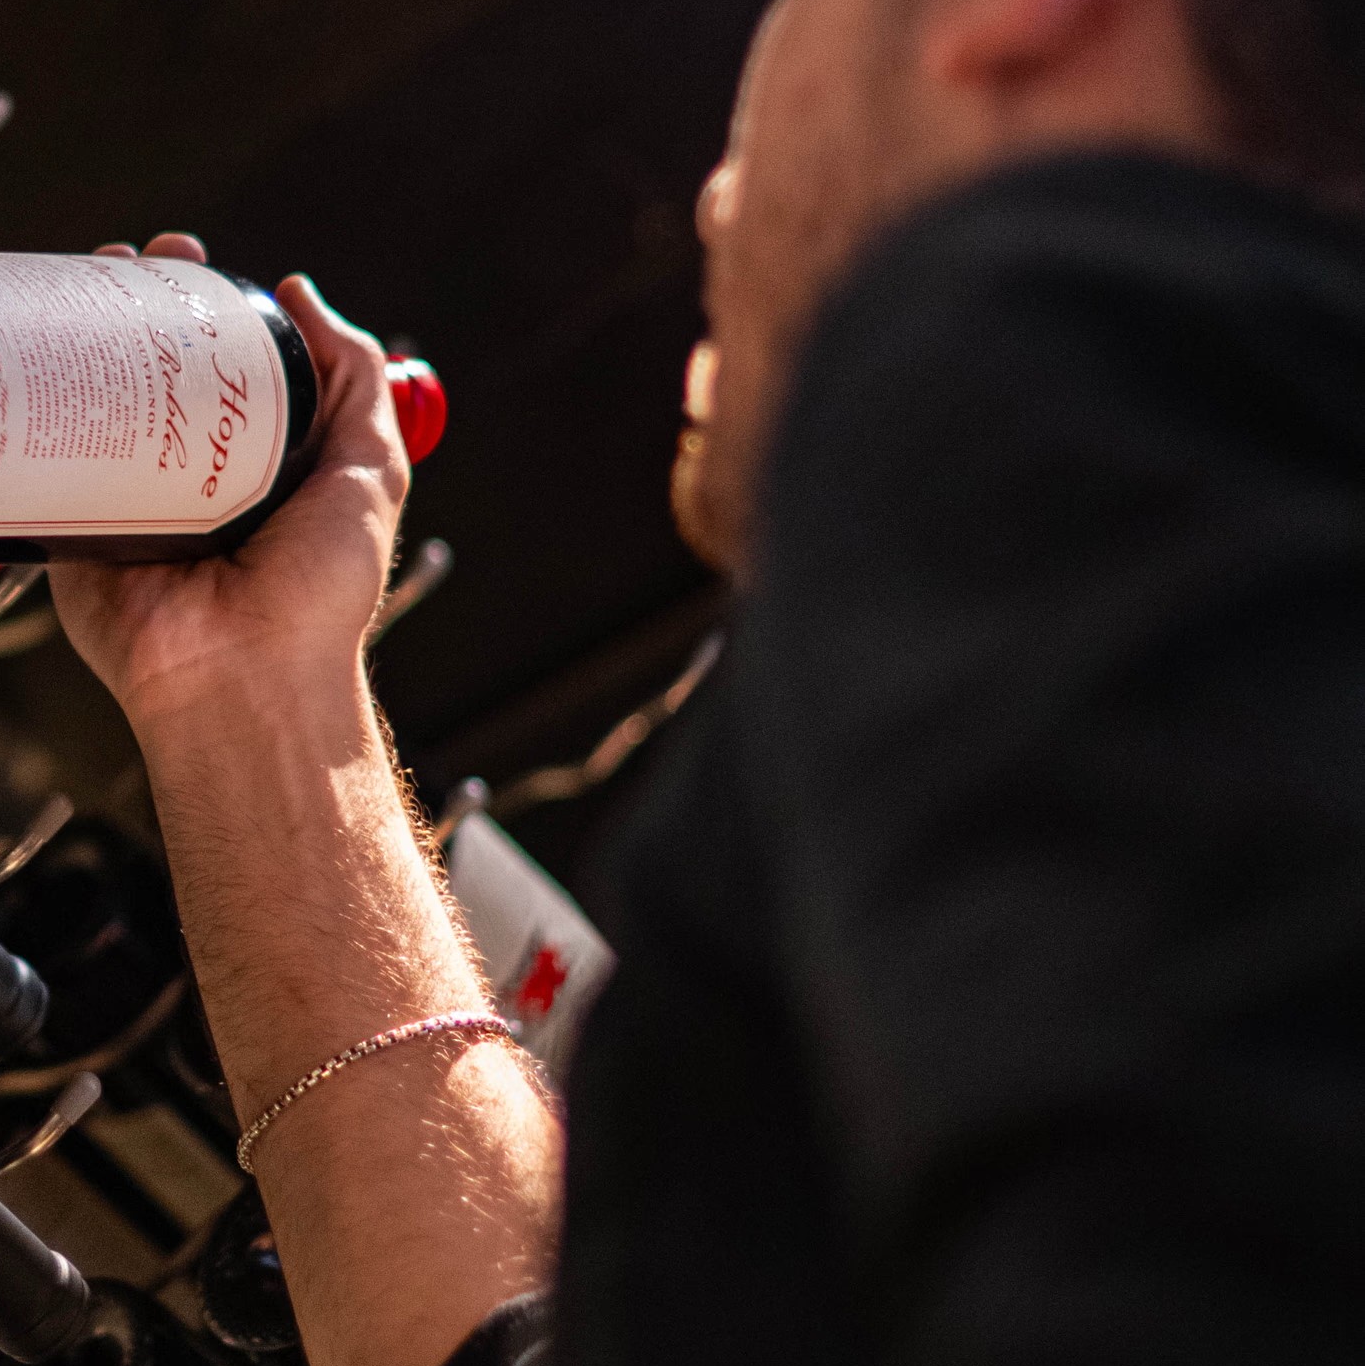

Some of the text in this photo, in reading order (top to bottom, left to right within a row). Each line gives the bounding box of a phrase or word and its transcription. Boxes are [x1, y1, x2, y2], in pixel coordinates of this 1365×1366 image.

[55, 350, 66, 381] FROM
[131, 328, 155, 438] SAUVIGNON
[25, 375, 33, 412] OFTEN
[34, 375, 42, 432] ELEVATED
[51, 370, 59, 430] ALLOWING
[118, 359, 130, 460] NAME ROUGHLY
[144, 321, 188, 475] Robles
[60, 416, 68, 459] PACIFIC
[67, 404, 77, 459] EVENINGS
[85, 420, 94, 459] WHERE
[93, 419, 103, 459] NATIVE
[127, 429, 137, 460] MOST
[201, 353, 247, 499] Hope
[31, 439, 39, 459] SEA
[41, 445, 46, 459] AT
[50, 437, 58, 459] THE
[110, 437, 118, 459] AND
